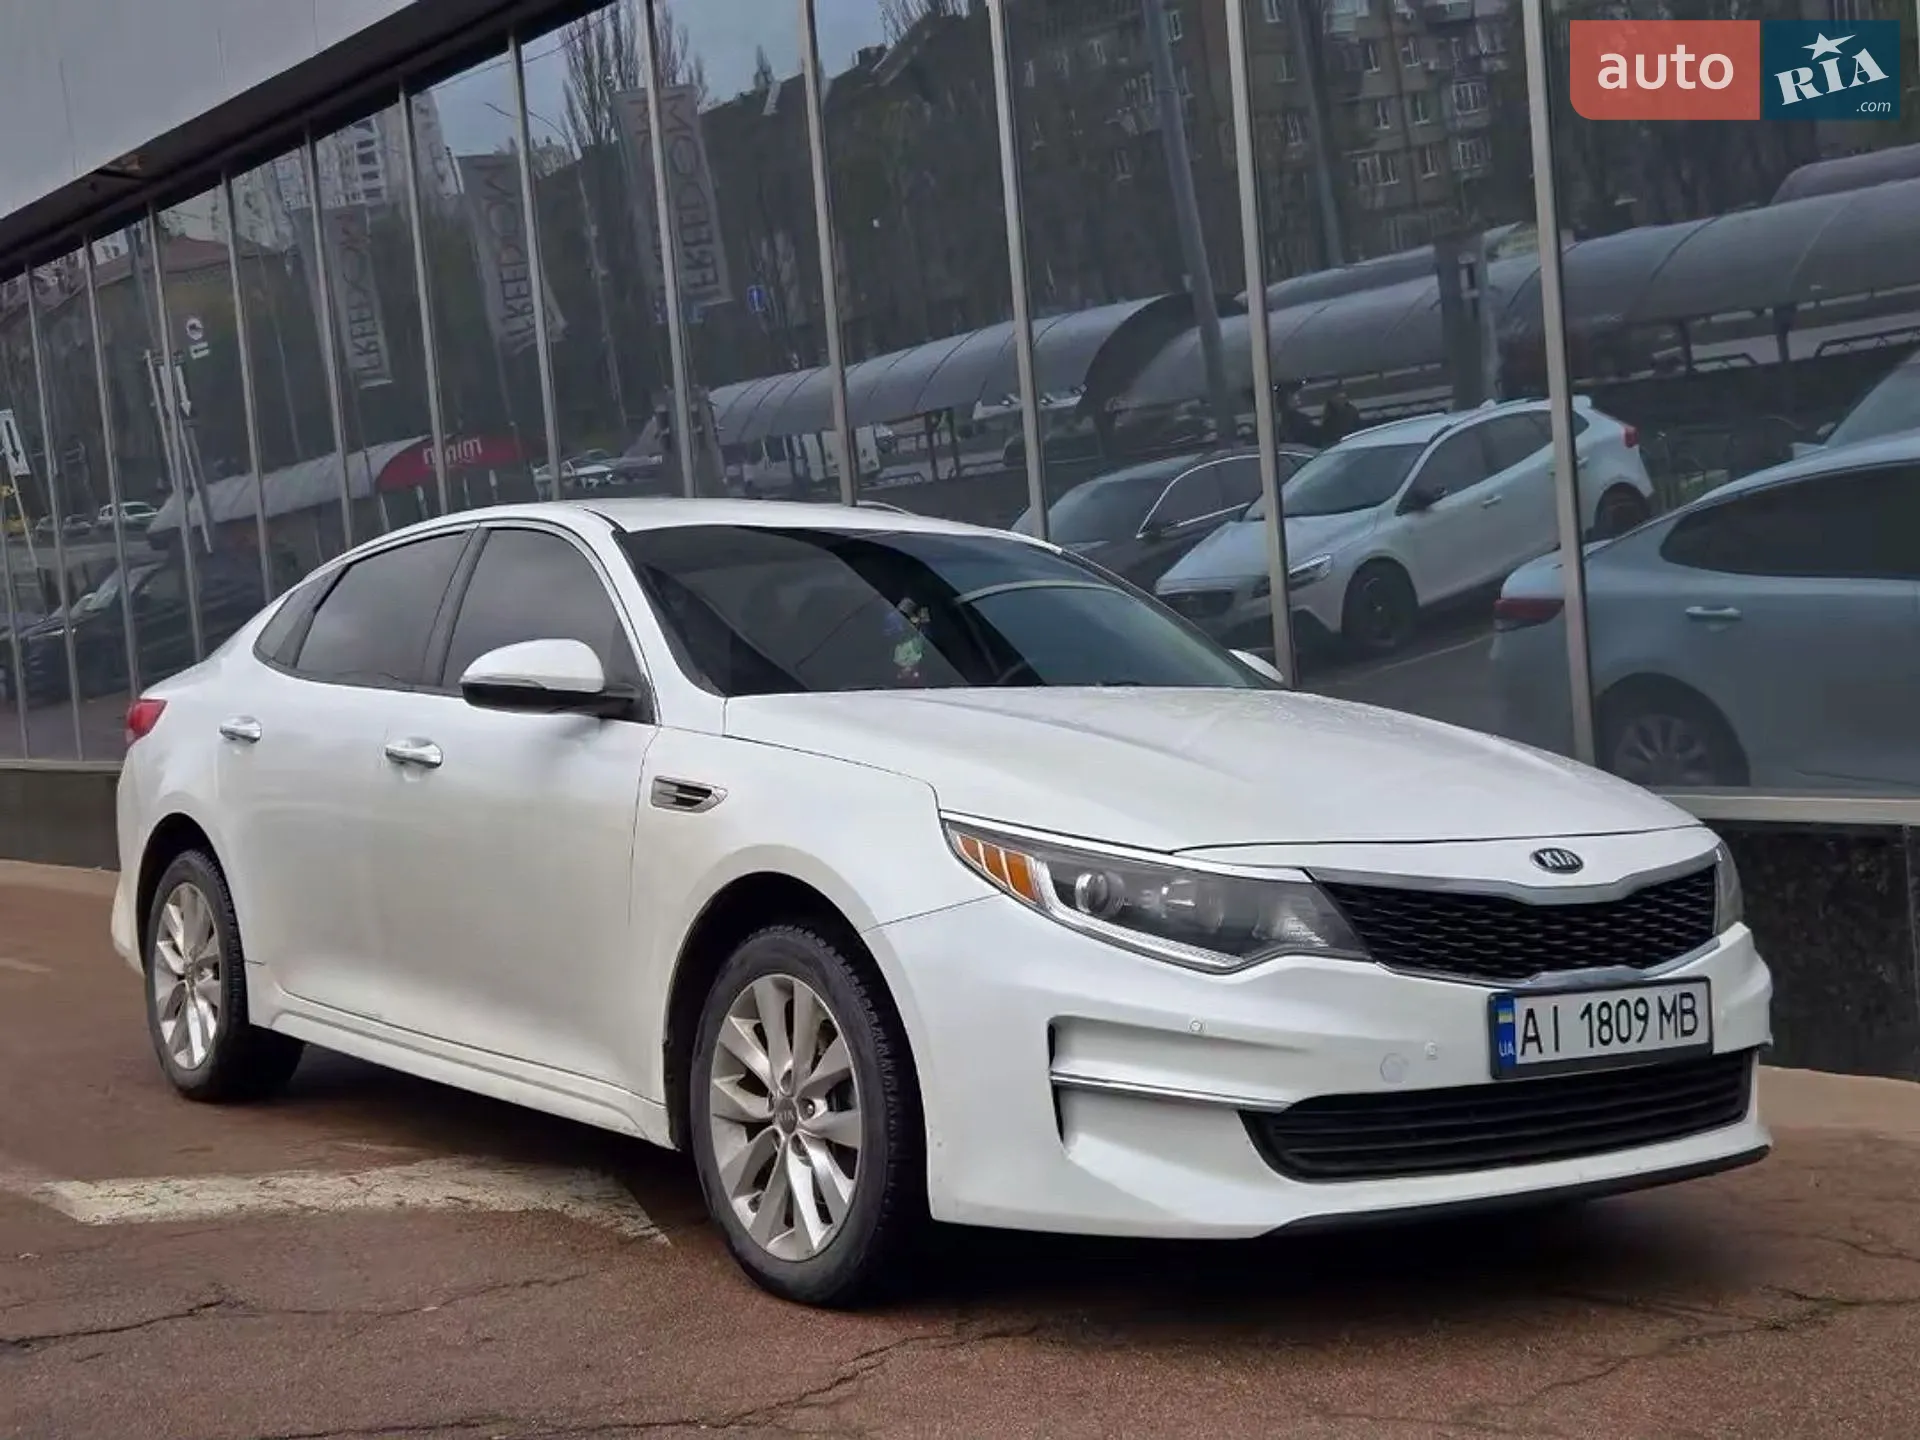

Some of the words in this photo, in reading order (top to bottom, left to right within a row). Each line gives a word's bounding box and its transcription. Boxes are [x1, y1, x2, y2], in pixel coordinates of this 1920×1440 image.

[1538, 850, 1579, 867] KIA
[1521, 1005, 1560, 1056] AI
[1580, 997, 1649, 1049] 1809
[1658, 992, 1699, 1041] MB
[1499, 1041, 1516, 1057] UA
